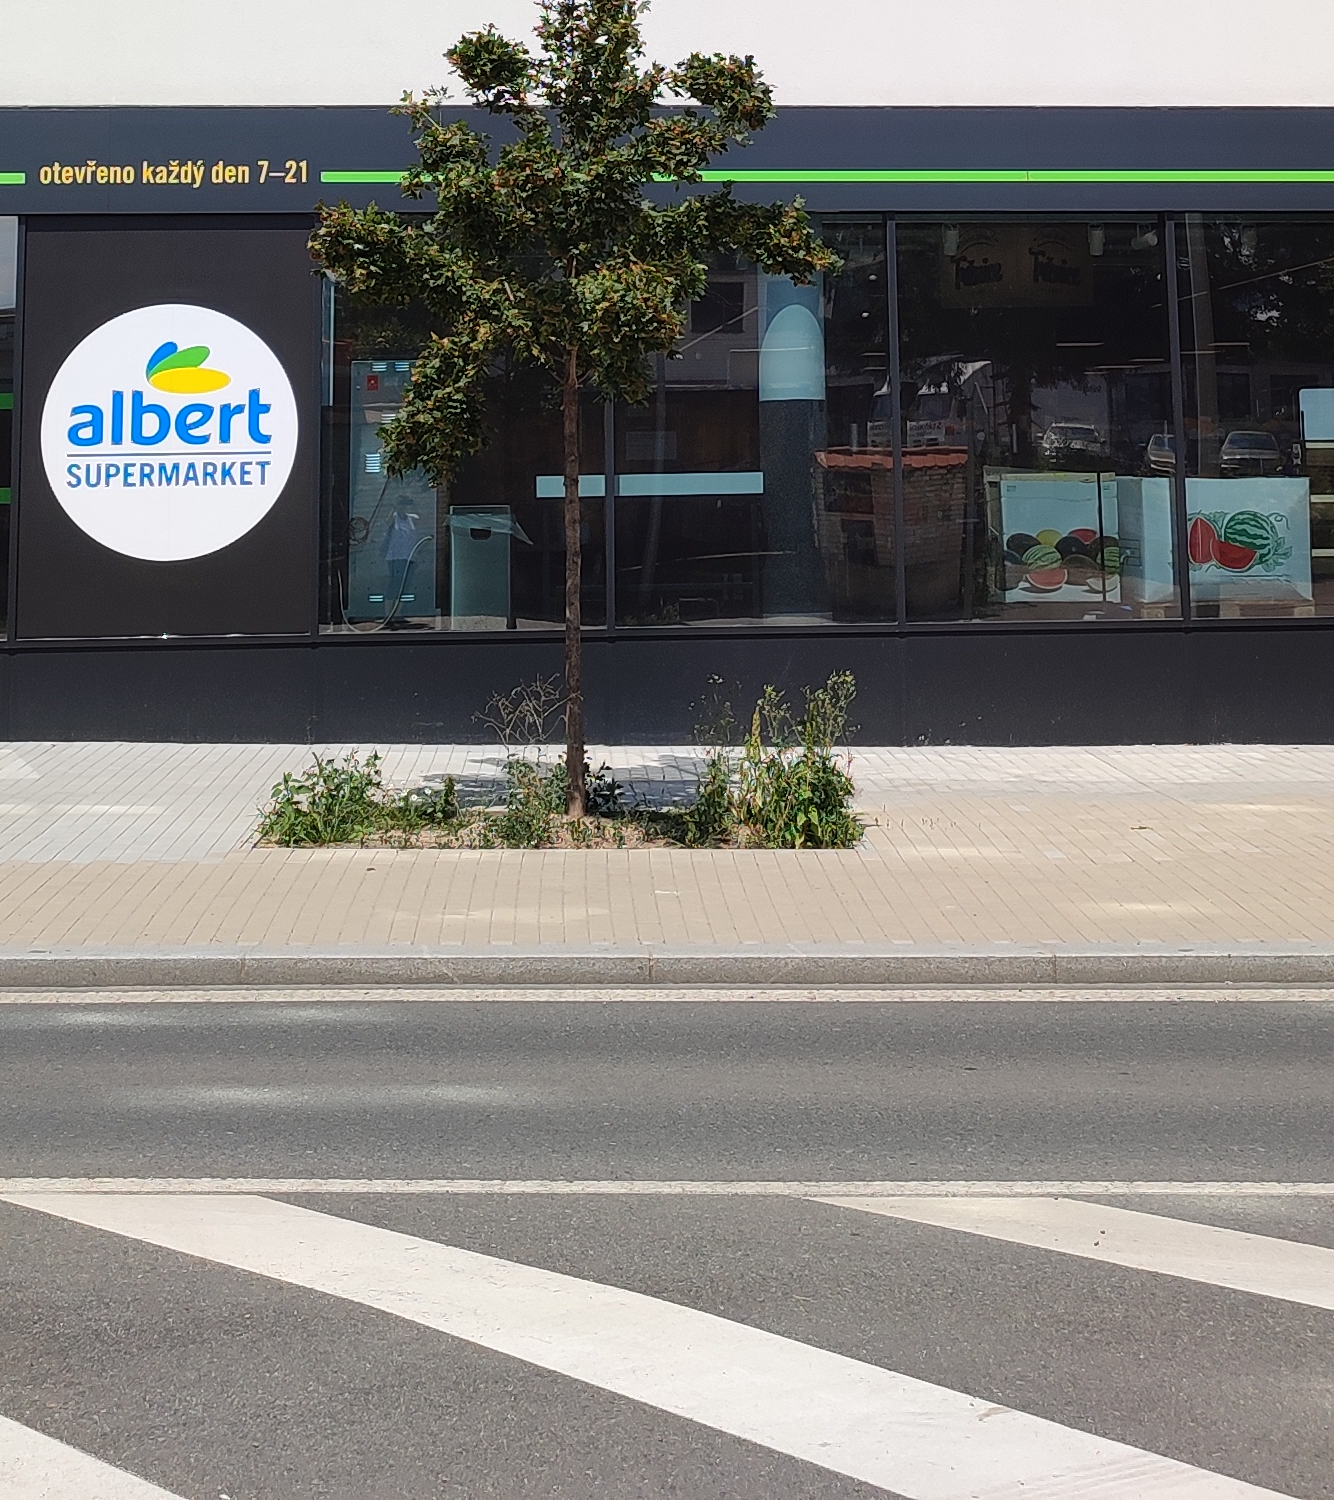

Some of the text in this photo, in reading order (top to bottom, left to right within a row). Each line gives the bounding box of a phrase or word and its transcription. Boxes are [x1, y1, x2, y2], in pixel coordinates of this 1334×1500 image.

[39, 160, 135, 184] otevřeno
[141, 160, 205, 189] každý
[211, 160, 250, 184] den
[67, 387, 272, 447] albert
[66, 460, 272, 488] SUPERMARKET
